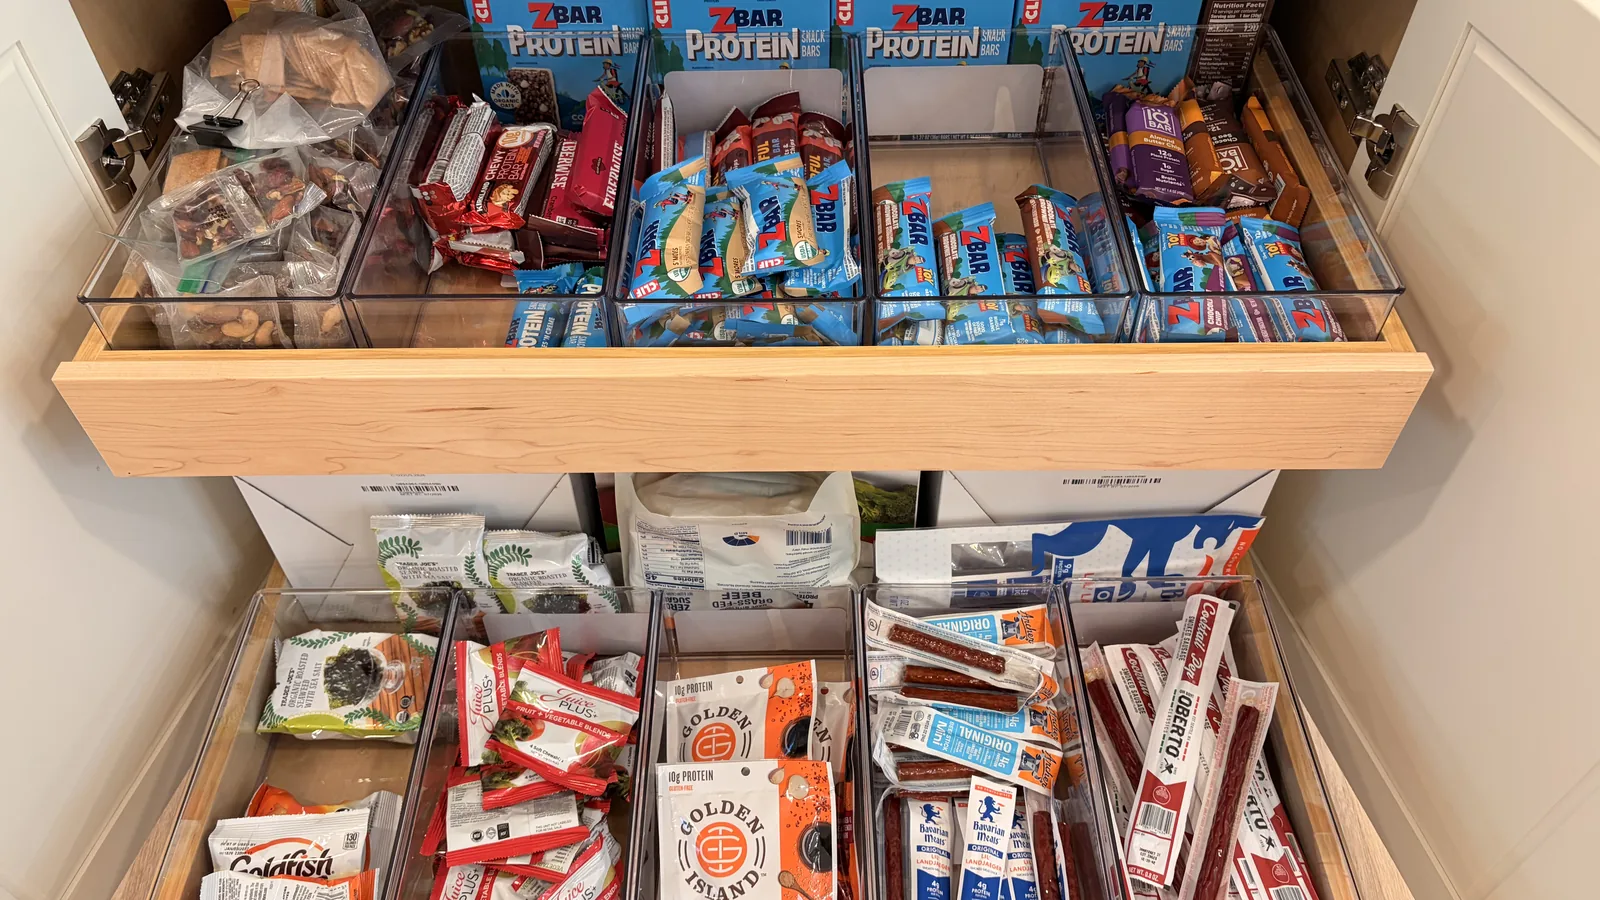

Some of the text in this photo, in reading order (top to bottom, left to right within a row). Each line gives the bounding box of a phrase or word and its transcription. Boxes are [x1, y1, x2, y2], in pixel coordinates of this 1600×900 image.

[801, 30, 826, 43] SNACK
[981, 29, 1006, 42] SNACK
[1166, 26, 1191, 38] SNACK
[507, 25, 623, 56] PROTEIN
[686, 28, 800, 60] PROTEIN
[866, 26, 980, 59] PROTEIN
[1164, 40, 1184, 52] BARS
[801, 45, 821, 57] BARS
[980, 44, 1001, 56] BARS
[490, 82, 520, 95] MADE WITH
[1147, 107, 1171, 126] IQ
[1148, 120, 1172, 133] BAR
[1143, 138, 1182, 151] Butter Chip
[1149, 134, 1175, 144] Almond
[485, 150, 506, 181] CHEWY
[497, 148, 518, 180] PROTEIN
[1163, 155, 1181, 163] Protein
[508, 164, 521, 180] BAR
[476, 181, 492, 213] KIRKLAND
[1167, 232, 1180, 249] TOY
[1264, 242, 1280, 258] TOY
[758, 257, 784, 269] CLIF
[923, 267, 934, 285] TOY
[635, 281, 659, 298] CLIF
[546, 317, 556, 333] CREME
[1215, 310, 1223, 327] CHIP
[1064, 563, 1072, 574] 9g
[645, 573, 704, 584] Calories 45
[712, 598, 773, 608] GRASS-FED
[721, 591, 761, 600] BEEF
[1019, 609, 1036, 645] Archer
[1178, 616, 1195, 661] SMOKED SAUSAGE
[1184, 602, 1217, 679] Cocktail Pep
[280, 667, 295, 707] TRADER JOE'S
[288, 652, 309, 708] ORGANIC ROASTED
[304, 662, 323, 709] WITH SEA SALT
[296, 679, 310, 709] SEAWEED
[675, 681, 713, 696] 10g PROTEIN
[1121, 667, 1147, 715] SMOKED SAUSAGE
[540, 687, 596, 708] Juice
[470, 683, 495, 734] Juice
[515, 705, 537, 717] FRUIT
[544, 711, 585, 730] VEGETABLE
[584, 725, 613, 740] BLENDS
[682, 706, 752, 739] GOLDEN
[1164, 708, 1173, 733] CLASSICS
[1165, 694, 1193, 758] OBERTO
[932, 721, 947, 745] Mini
[959, 725, 1013, 753] ORIGINAL
[534, 745, 544, 753] Soft
[942, 735, 951, 752] STICK
[668, 770, 714, 784] 10g PROTEIN
[1040, 749, 1058, 789] Archer
[681, 800, 764, 836] GOLDEN
[920, 823, 949, 837] Bavarian
[973, 820, 1005, 837] Bavarian
[346, 833, 357, 842] 130
[924, 833, 945, 846] Meats
[977, 832, 1000, 845] Meats
[921, 846, 948, 857] ORIGINAL
[972, 845, 1000, 857] ORIGINAL
[230, 849, 334, 880] Goldfish
[965, 858, 1002, 871] LANDJAEGER
[685, 870, 760, 900] ISLAND
[926, 887, 943, 896] PROTEIN
[931, 880, 940, 888] 4g
[977, 881, 987, 890] 4g
[971, 888, 991, 897] PROTEIN
